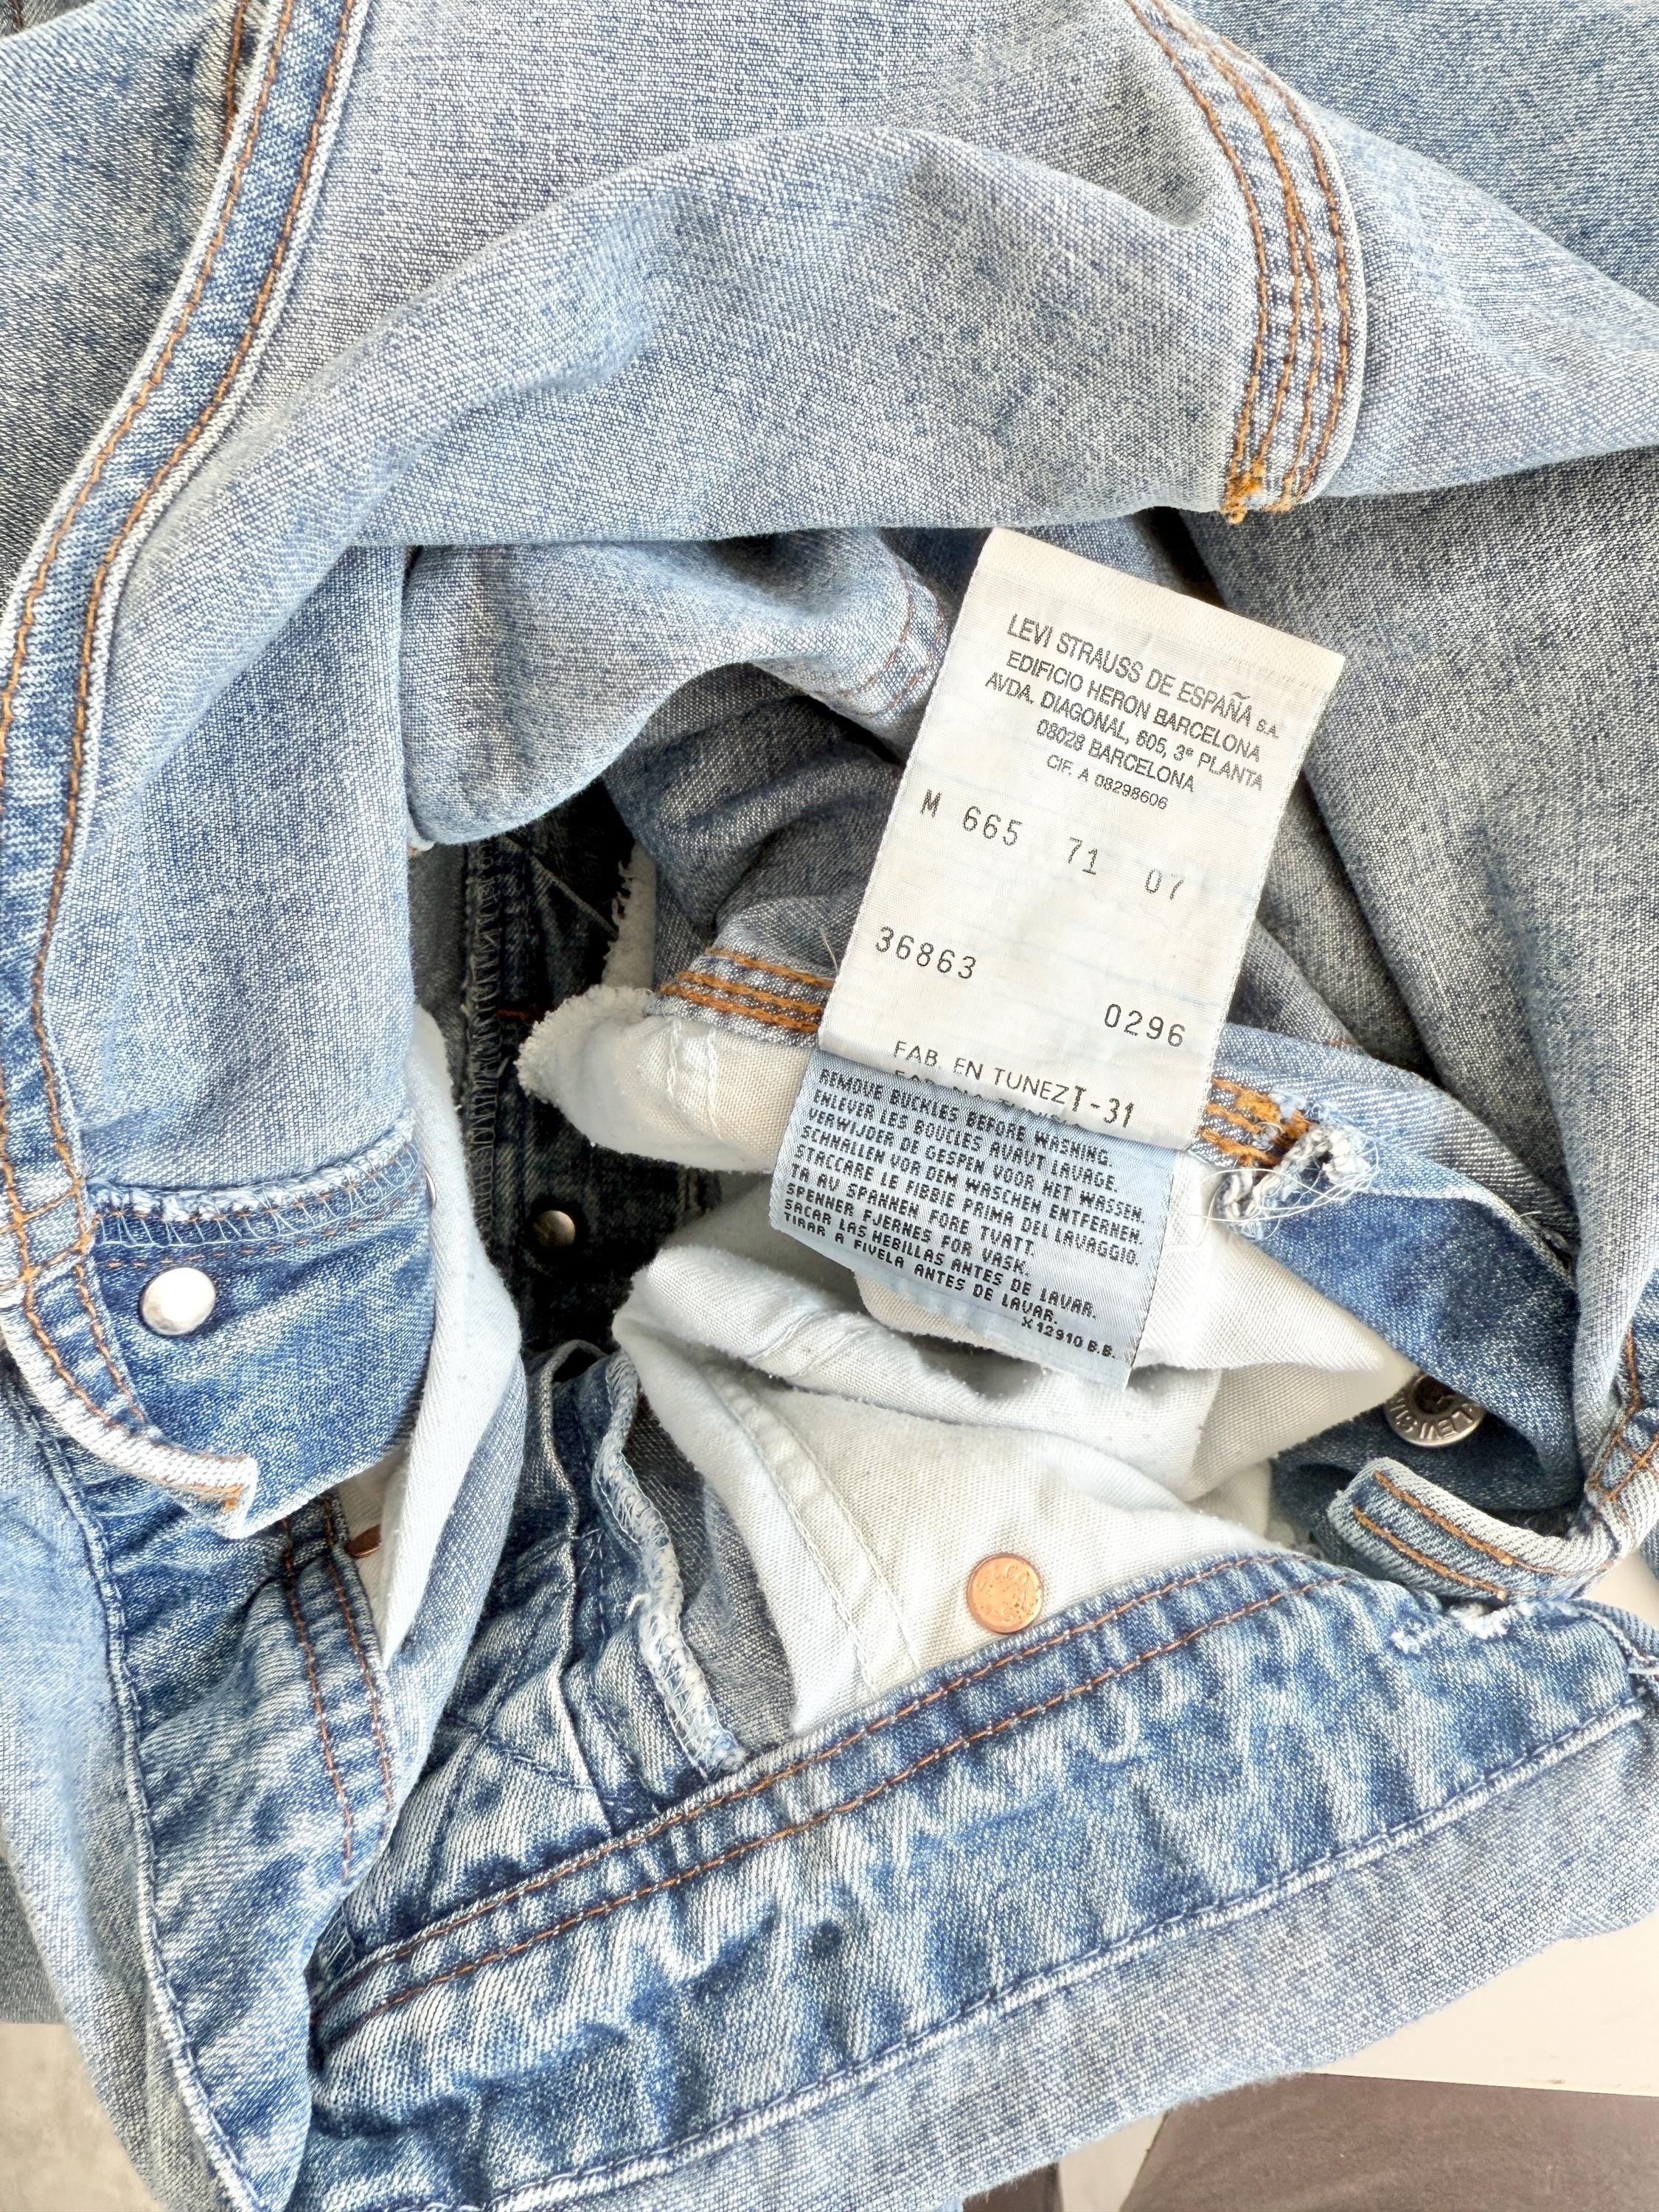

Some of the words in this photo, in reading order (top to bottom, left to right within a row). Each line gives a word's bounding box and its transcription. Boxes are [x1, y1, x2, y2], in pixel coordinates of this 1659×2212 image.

[1006, 613, 1053, 648] LEVI
[1055, 630, 1144, 684] STRAUSS
[1144, 667, 1176, 698] DE
[1175, 680, 1253, 728] ESPAÑA
[1006, 649, 1084, 692] EDIFICIO
[1086, 679, 1152, 720] HERON
[1152, 706, 1260, 762] BARCELONA
[1035, 718, 1086, 752] 08028
[1087, 737, 1194, 793] BARCELONA
[1039, 689, 1130, 745] DIAGONAL,
[1135, 728, 1167, 759] 605,
[1196, 751, 1262, 791] PLANTA
[1077, 767, 1089, 782] A
[1093, 773, 1169, 810] 08298606
[919, 788, 941, 818] M
[961, 804, 1023, 846] 665
[1067, 836, 1099, 876] 71
[874, 925, 976, 980] 36863
[953, 1057, 984, 1080] EN
[1103, 1002, 1186, 1048] 0296
[813, 1088, 875, 1121] ENLEVER
[879, 1108, 909, 1130] LES
[913, 1118, 983, 1152] BOUCLES
[1050, 1159, 1119, 1193] LAVAGE.
[818, 1067, 884, 1101] REMOVE
[888, 1088, 959, 1123] BUCKLES
[965, 1110, 1026, 1143] BEFORE
[790, 1162, 810, 1183] TA
[815, 1172, 840, 1192] AV
[845, 1182, 919, 1218] SPANNEN
[928, 1208, 970, 1236] FORE
[979, 1224, 1034, 1256] TVATT.
[793, 1143, 874, 1182] STACCARE
[880, 1172, 899, 1190] LE
[904, 1179, 956, 1208] FIBBIE
[961, 1197, 1014, 1227] PRIMA
[1020, 1216, 1048, 1239] DEL
[1053, 1226, 1138, 1266] LAVAGGIO.
[799, 1124, 886, 1164] SCHNALLEN
[889, 1153, 922, 1176] VOR
[924, 1165, 959, 1187] DEM
[964, 1177, 1042, 1214] WASCHEN
[1048, 1203, 1143, 1245] ENTFERNEN.
[807, 1107, 894, 1147] VERWIJDER
[899, 1135, 919, 1155] DE
[925, 1144, 986, 1175] GESPEN
[992, 1164, 1035, 1191] VOOR
[1041, 1179, 1073, 1201] HET
[1078, 1189, 1145, 1224] WASSEN.
[783, 1197, 832, 1225] SACAR
[838, 1217, 867, 1239] LAS
[871, 1229, 945, 1266] HEBILLAS
[950, 1257, 1004, 1287] ANTES
[1009, 1277, 1032, 1296] DE
[1039, 1287, 1096, 1318] LAVAR.
[783, 1211, 826, 1237] TIRAR
[834, 1231, 844, 1244] A
[852, 1238, 905, 1269] FIVELA
[913, 1262, 966, 1291] ANTES
[972, 1283, 993, 1301] DE
[1001, 1293, 1057, 1324] LAVAR.
[785, 1181, 855, 1217] SPENNER
[861, 1208, 932, 1243] FJERNES
[940, 1234, 973, 1257] FOR
[981, 1247, 1029, 1276] VASK.
